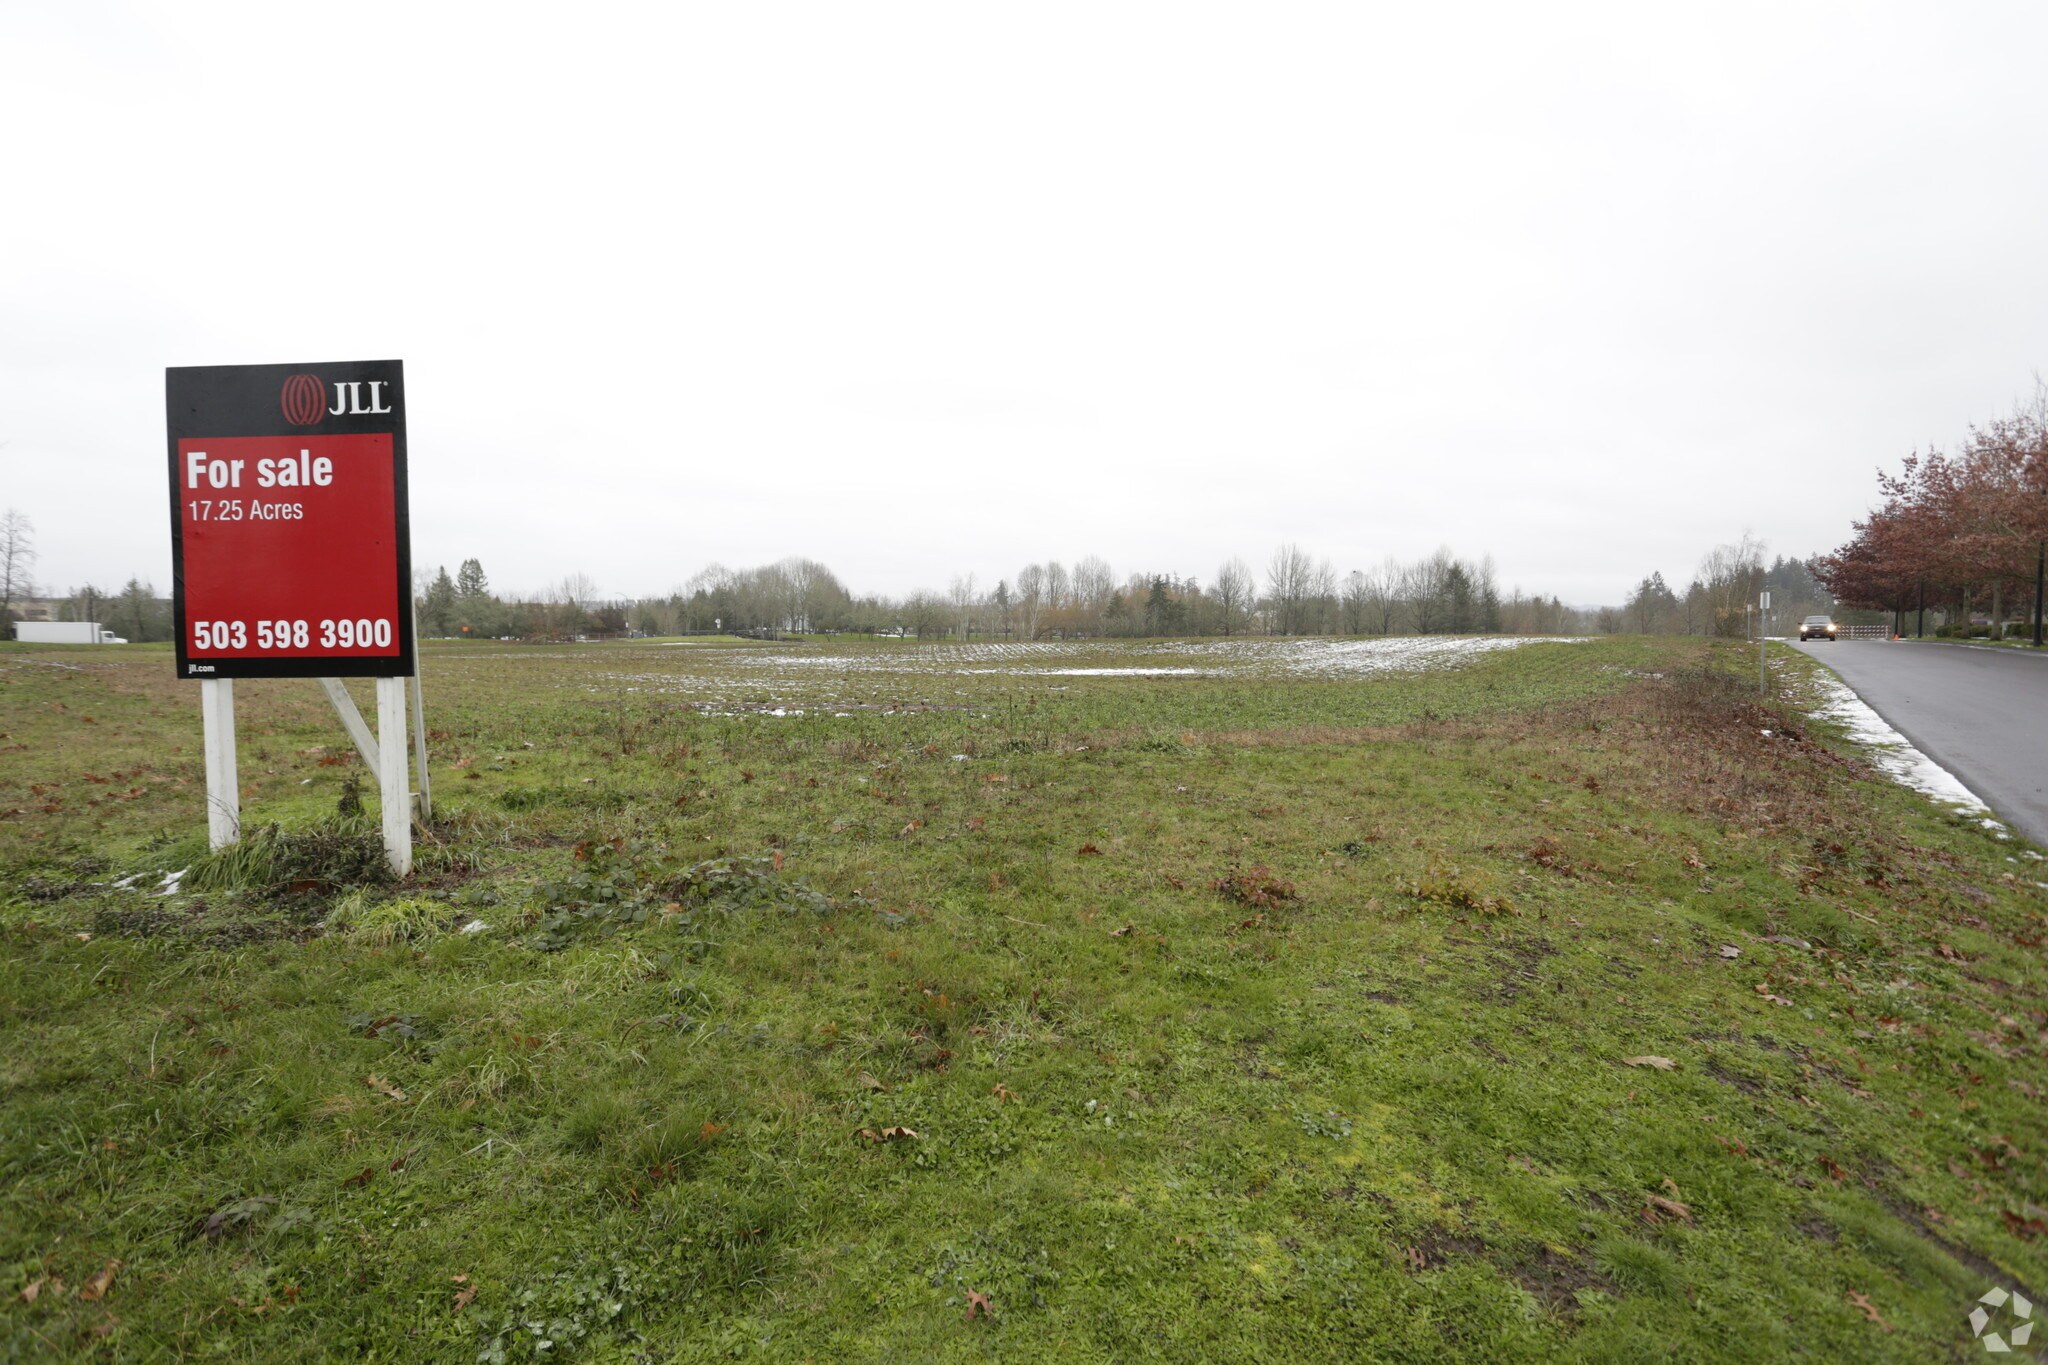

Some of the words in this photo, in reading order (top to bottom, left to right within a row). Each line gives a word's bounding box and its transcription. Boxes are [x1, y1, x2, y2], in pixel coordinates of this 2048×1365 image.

[328, 381, 392, 416] JLL
[187, 451, 245, 489] For
[257, 449, 333, 487] sale
[189, 500, 243, 521] 17.25
[250, 499, 304, 520] Acres
[194, 620, 247, 650] 503
[257, 620, 310, 649] 598
[319, 618, 392, 648] 3900
[188, 664, 215, 674] jll.com
